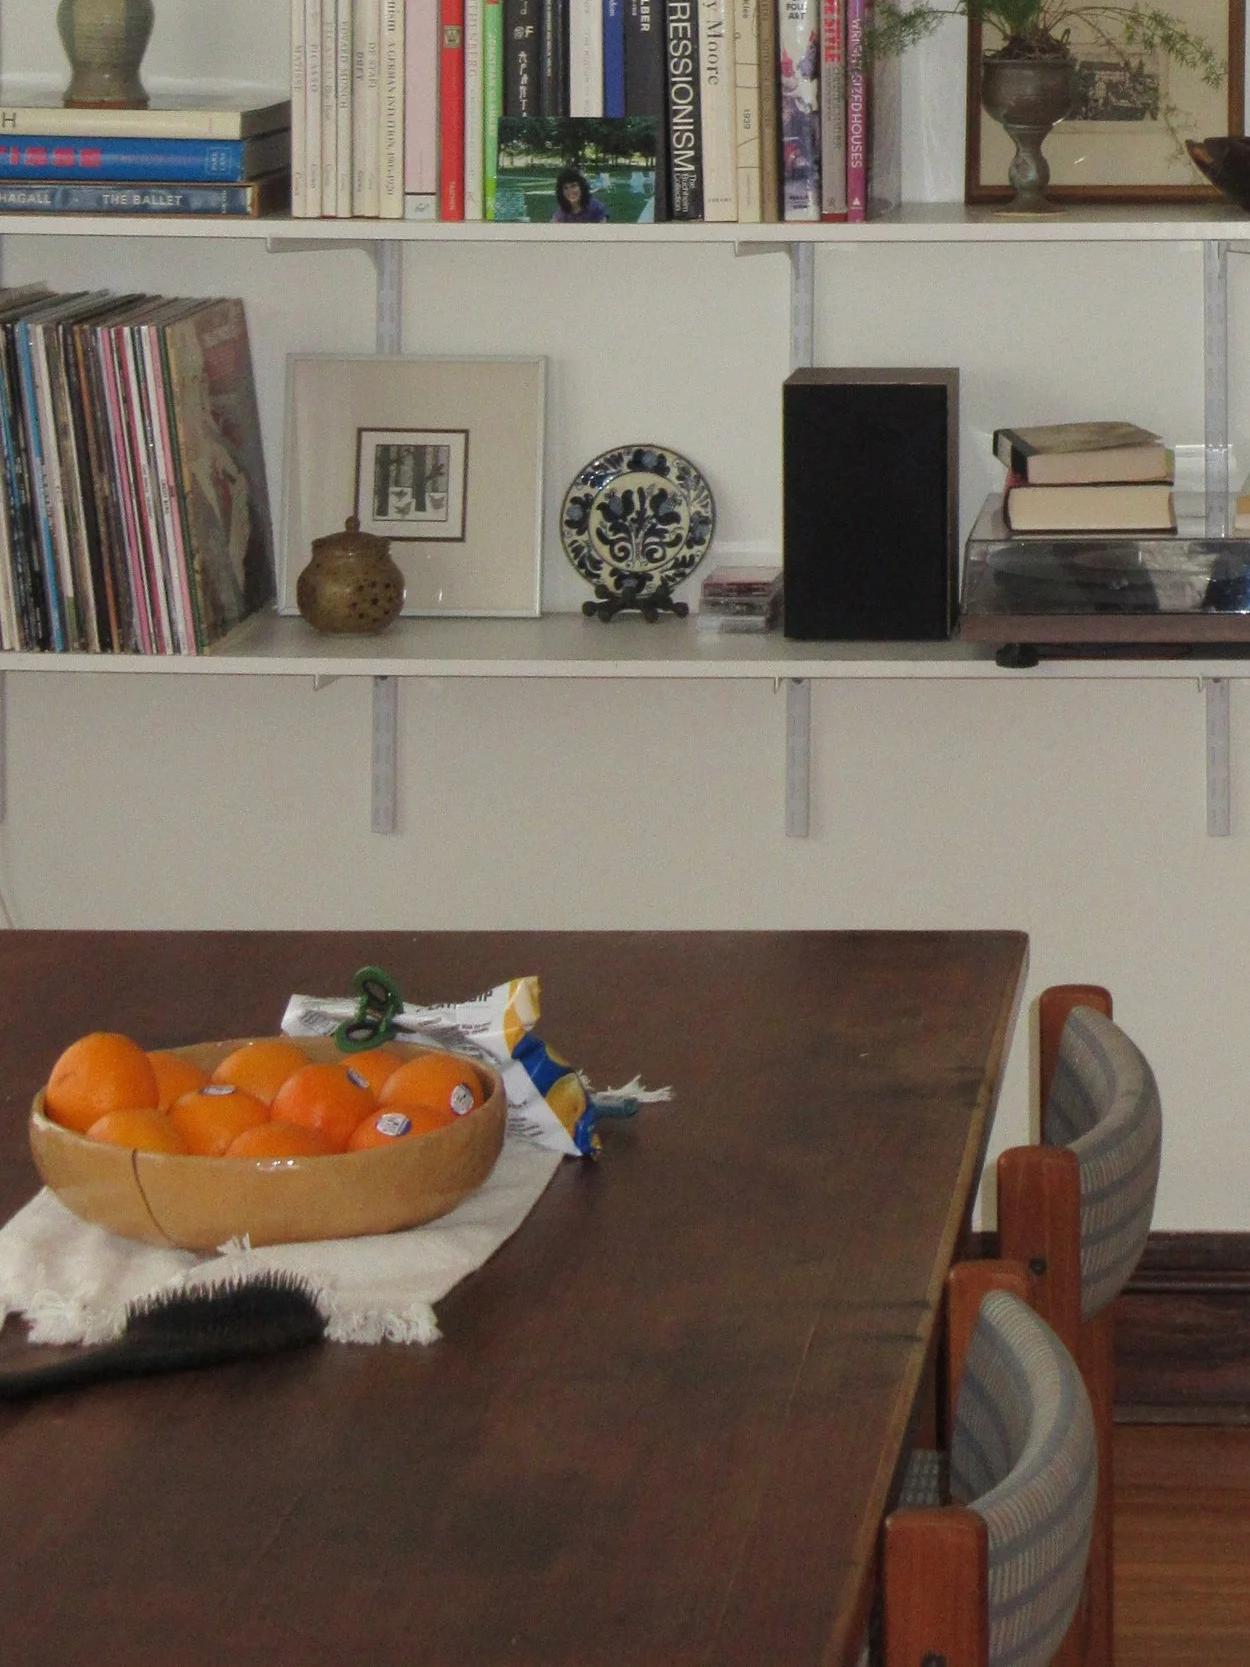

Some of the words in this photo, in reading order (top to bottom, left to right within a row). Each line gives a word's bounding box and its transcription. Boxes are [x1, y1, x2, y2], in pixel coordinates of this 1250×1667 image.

[705, 19, 724, 86] Moore
[824, 18, 841, 62] STYLE
[293, 45, 303, 91] MATISSE
[310, 44, 319, 92] PICASSO
[387, 50, 396, 92] GERMAN
[743, 108, 751, 130] 1939
[851, 113, 863, 169] HOUSES
[102, 194, 128, 205] THE
[133, 195, 183, 206] BALLET
[674, 173, 682, 213] Collection
[681, 173, 690, 213] Buchheim
[689, 173, 697, 189] The
